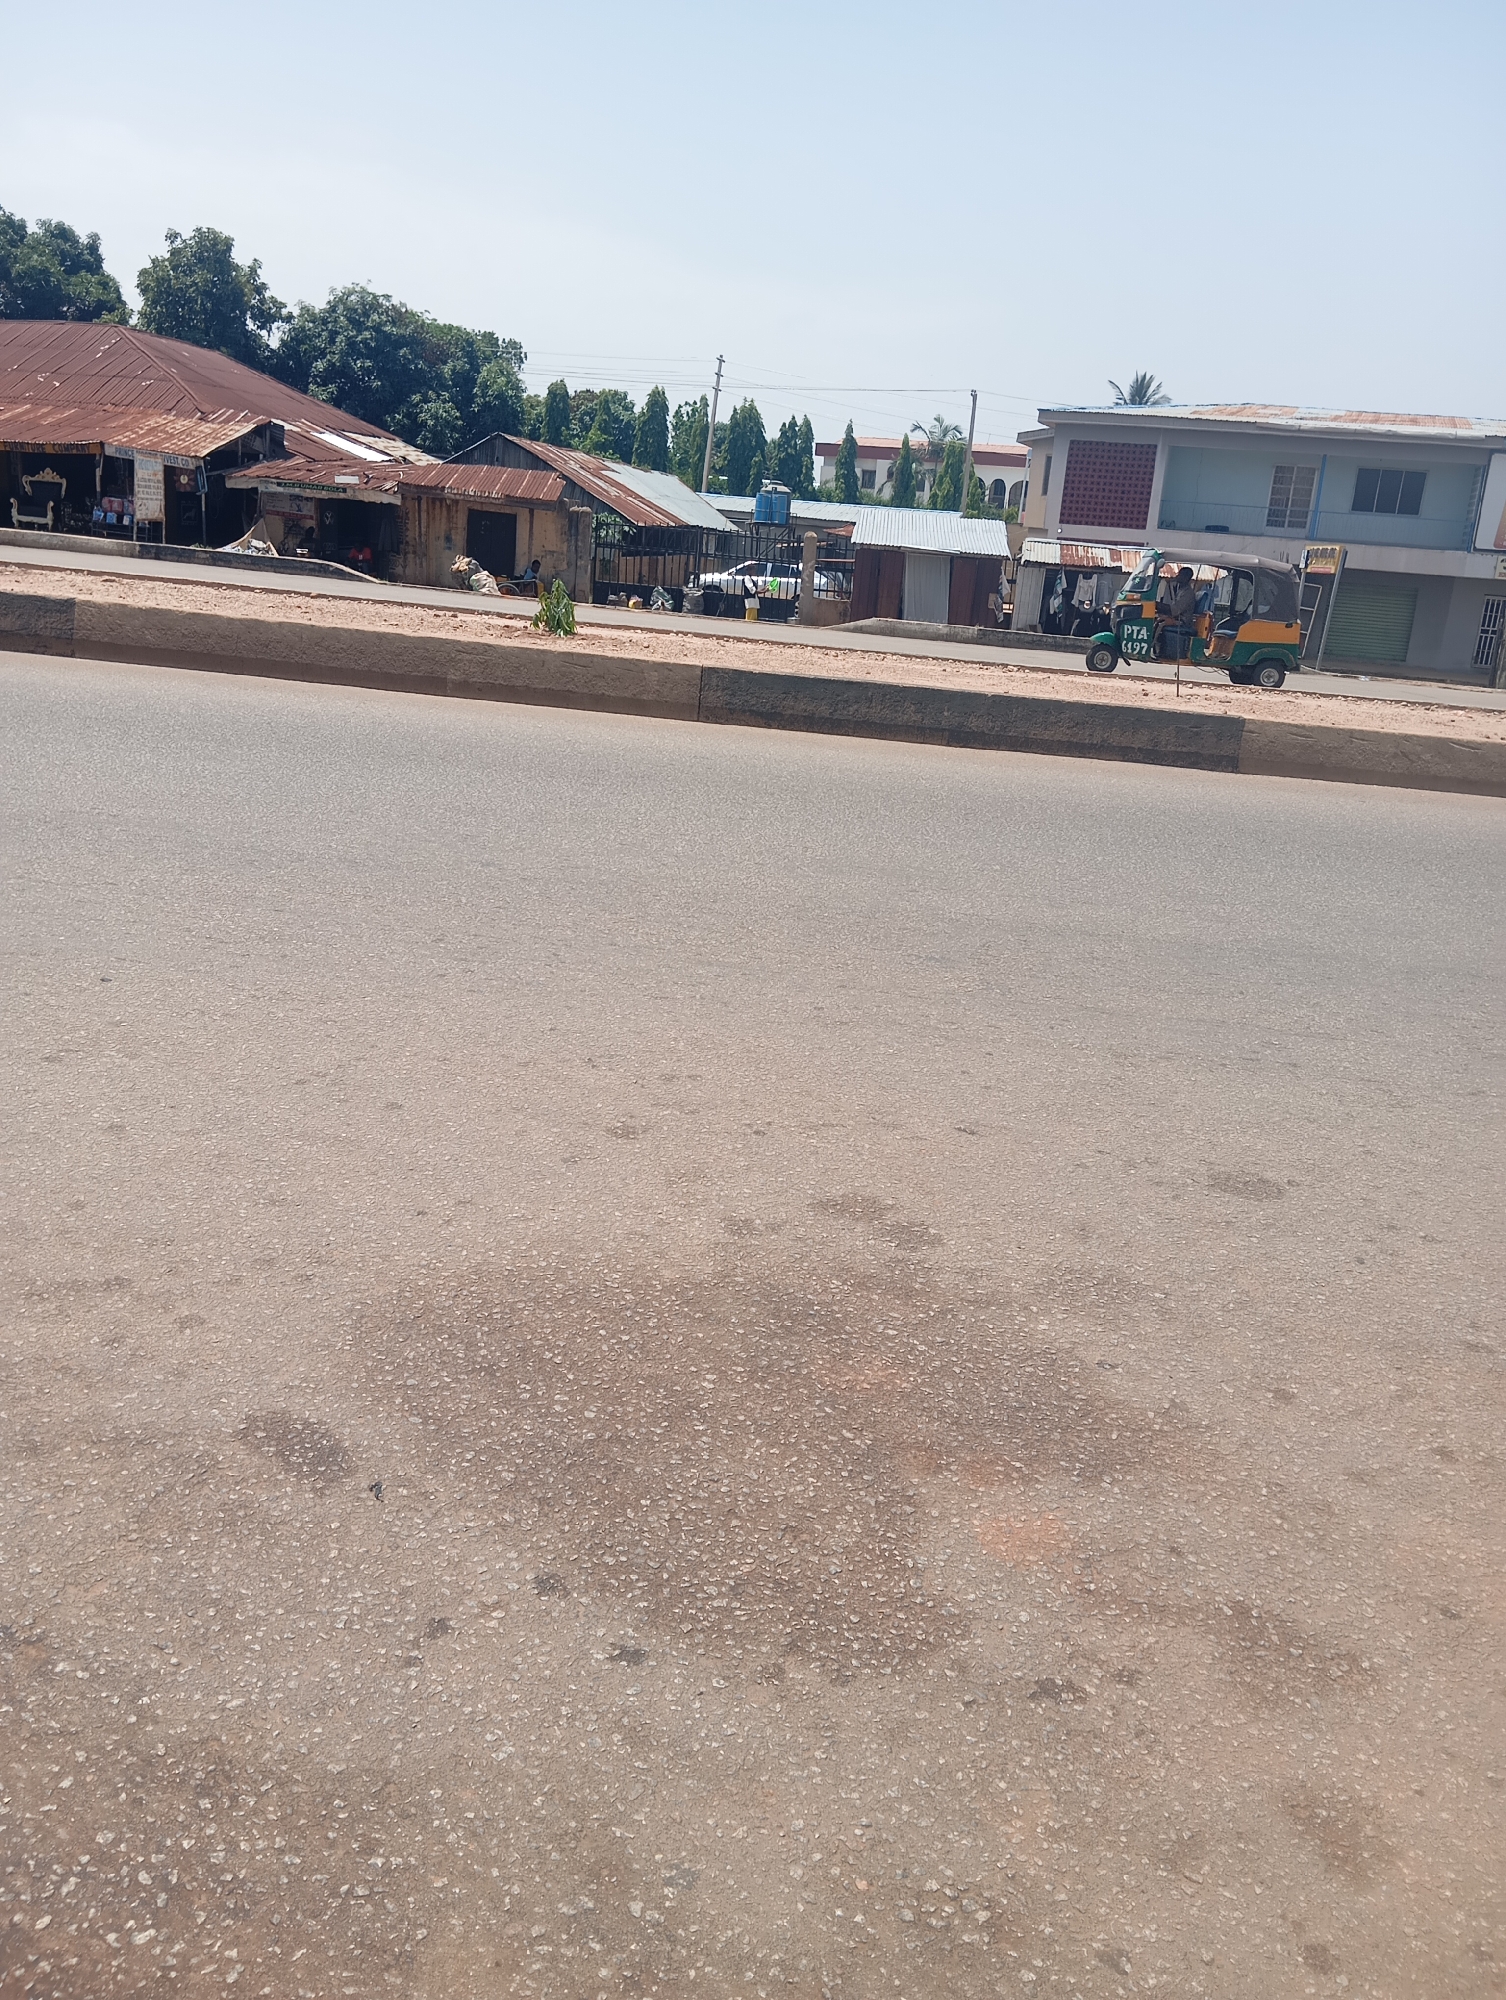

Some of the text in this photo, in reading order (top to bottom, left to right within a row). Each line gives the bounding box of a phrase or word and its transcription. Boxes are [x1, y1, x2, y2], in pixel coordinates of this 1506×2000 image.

[52, 443, 90, 454] COMPANY
[115, 447, 135, 459] PRINCE
[1124, 624, 1148, 640] PTA
[1121, 640, 1149, 655] 6197
